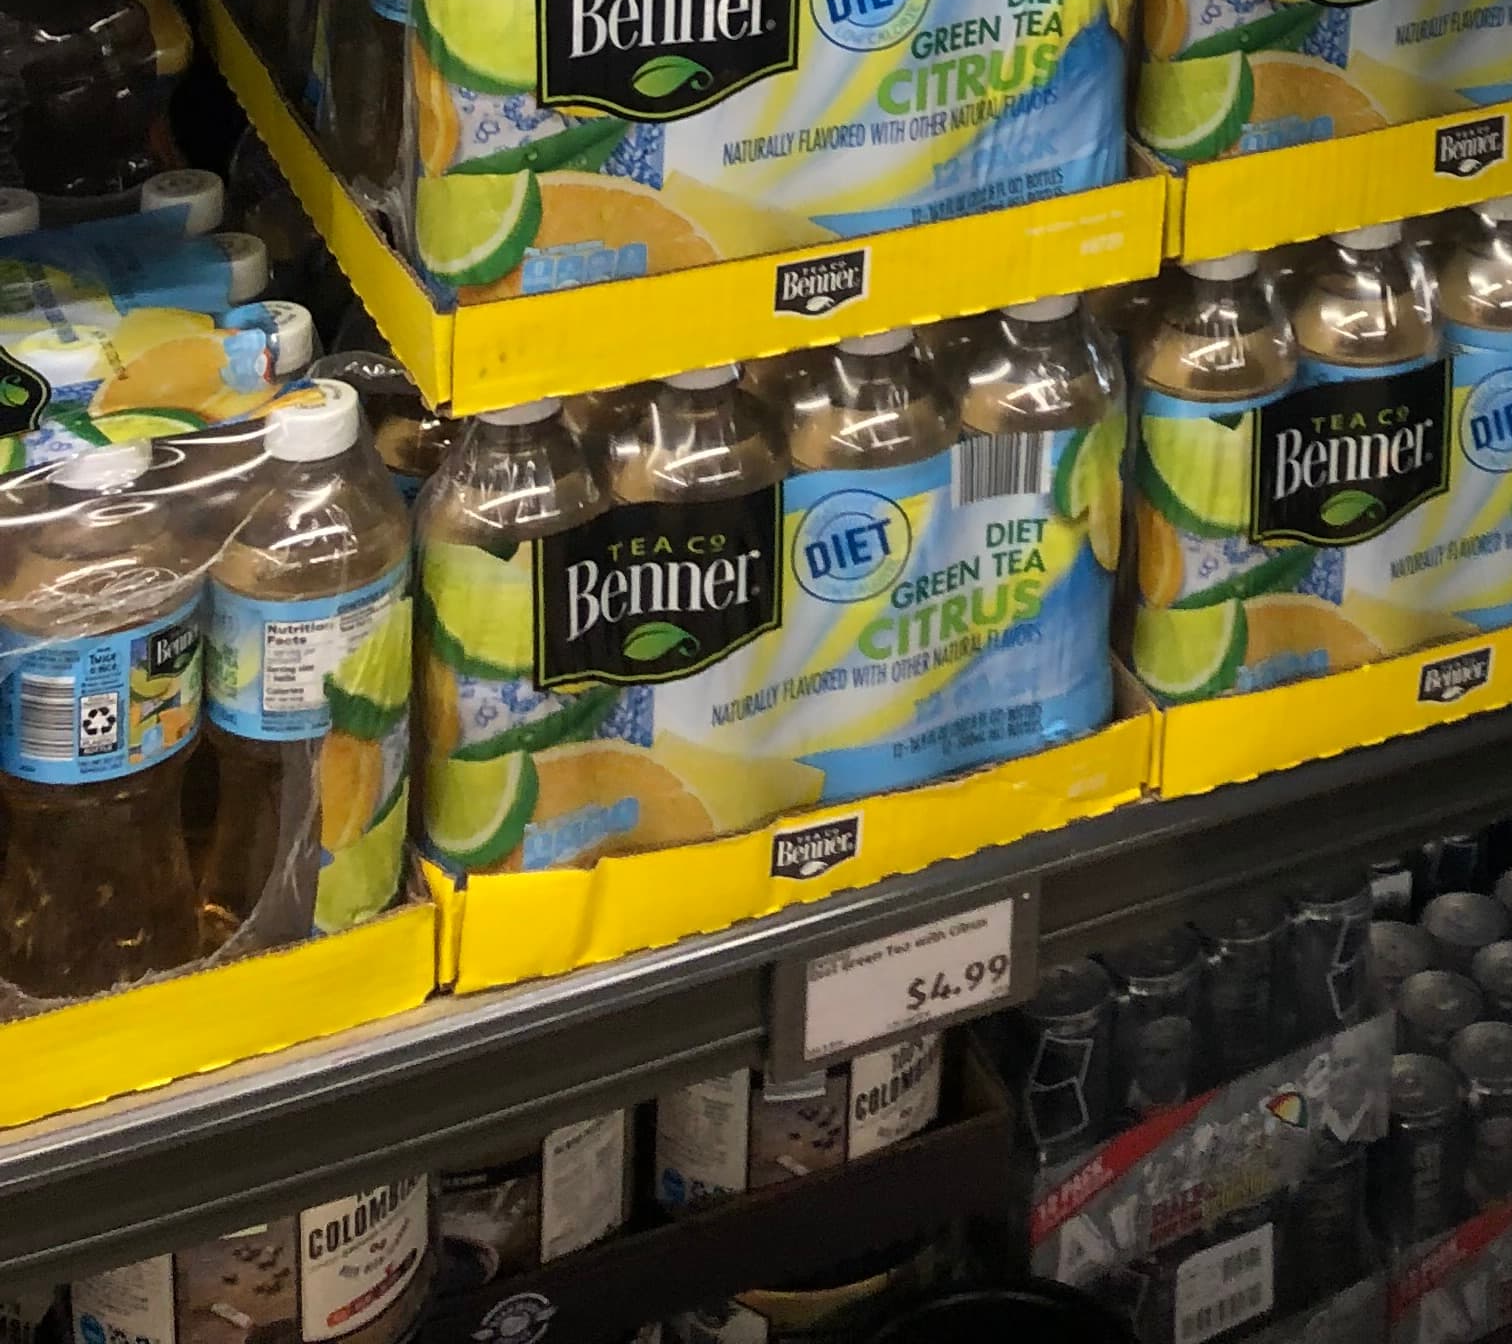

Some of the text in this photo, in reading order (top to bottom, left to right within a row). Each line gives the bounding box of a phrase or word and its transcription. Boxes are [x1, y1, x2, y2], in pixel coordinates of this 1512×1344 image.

[911, 11, 1065, 63] GREEN TEA
[1395, 15, 1449, 47] NATURALLY
[1451, 9, 1504, 34] FLAVORED
[878, 41, 1060, 116] CITRUS
[721, 122, 796, 167] NATURALLY
[799, 123, 867, 154] FLAVORED
[871, 118, 906, 146] WITH
[909, 111, 948, 142] OTHER
[951, 98, 1001, 130] NATURAL
[1440, 131, 1502, 163] Benner
[783, 266, 860, 301] Benner
[1311, 411, 1367, 434] TEA
[1274, 419, 1434, 501] Benner
[608, 538, 675, 562] TEA
[804, 517, 893, 579] DIET
[984, 519, 1049, 548] DIET
[567, 549, 762, 643] Benner
[890, 549, 1047, 609] GREEN TEA
[267, 636, 307, 644] Facts
[268, 623, 333, 634] Nutrition
[858, 580, 1045, 662] CITRUS
[711, 682, 779, 728] NATURALLY
[782, 667, 848, 702] FLAVORED
[851, 663, 887, 690] WITH
[890, 654, 929, 684] OTHER
[777, 832, 856, 869] Benner
[906, 954, 1009, 1010] $4.99
